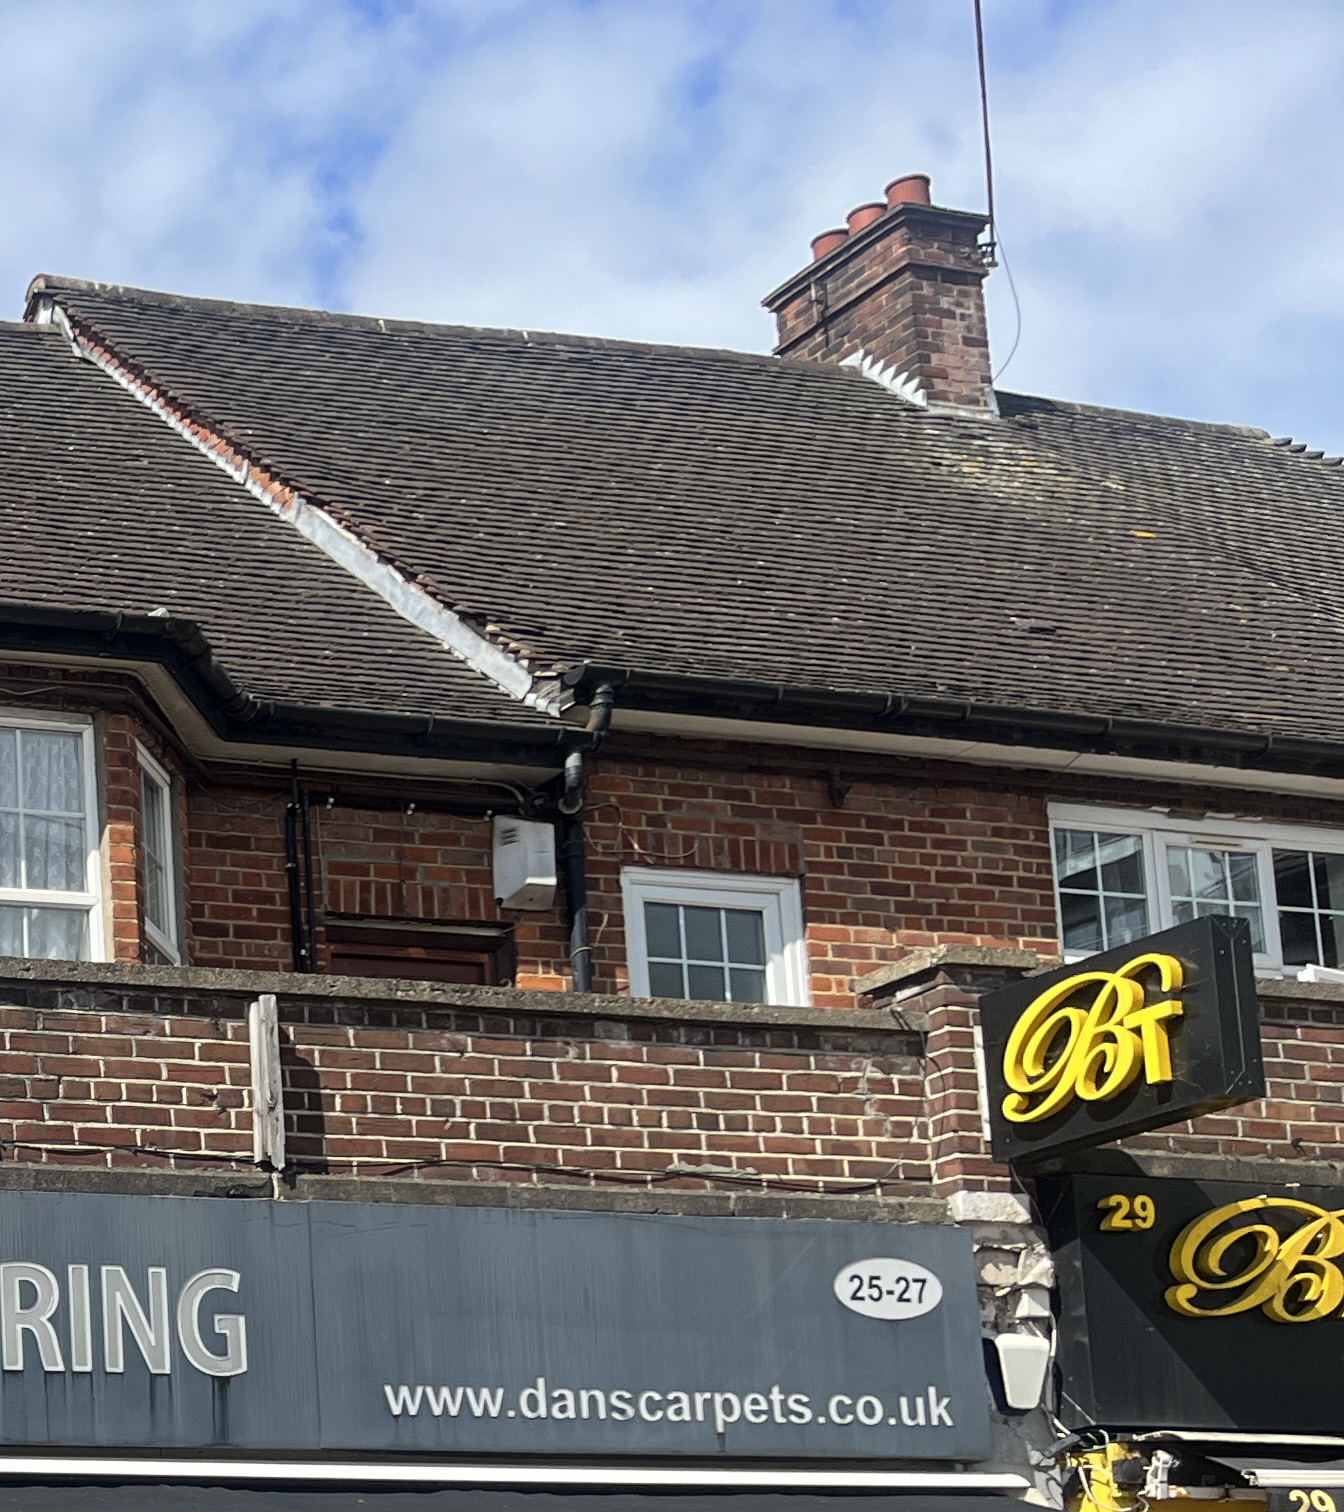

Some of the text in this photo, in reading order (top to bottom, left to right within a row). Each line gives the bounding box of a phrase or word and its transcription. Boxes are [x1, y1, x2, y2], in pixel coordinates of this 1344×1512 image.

[1099, 1195, 1156, 1232] 29
[848, 1275, 926, 1305] 25-27
[383, 1376, 955, 1434] www.danscarpets.co.uk
